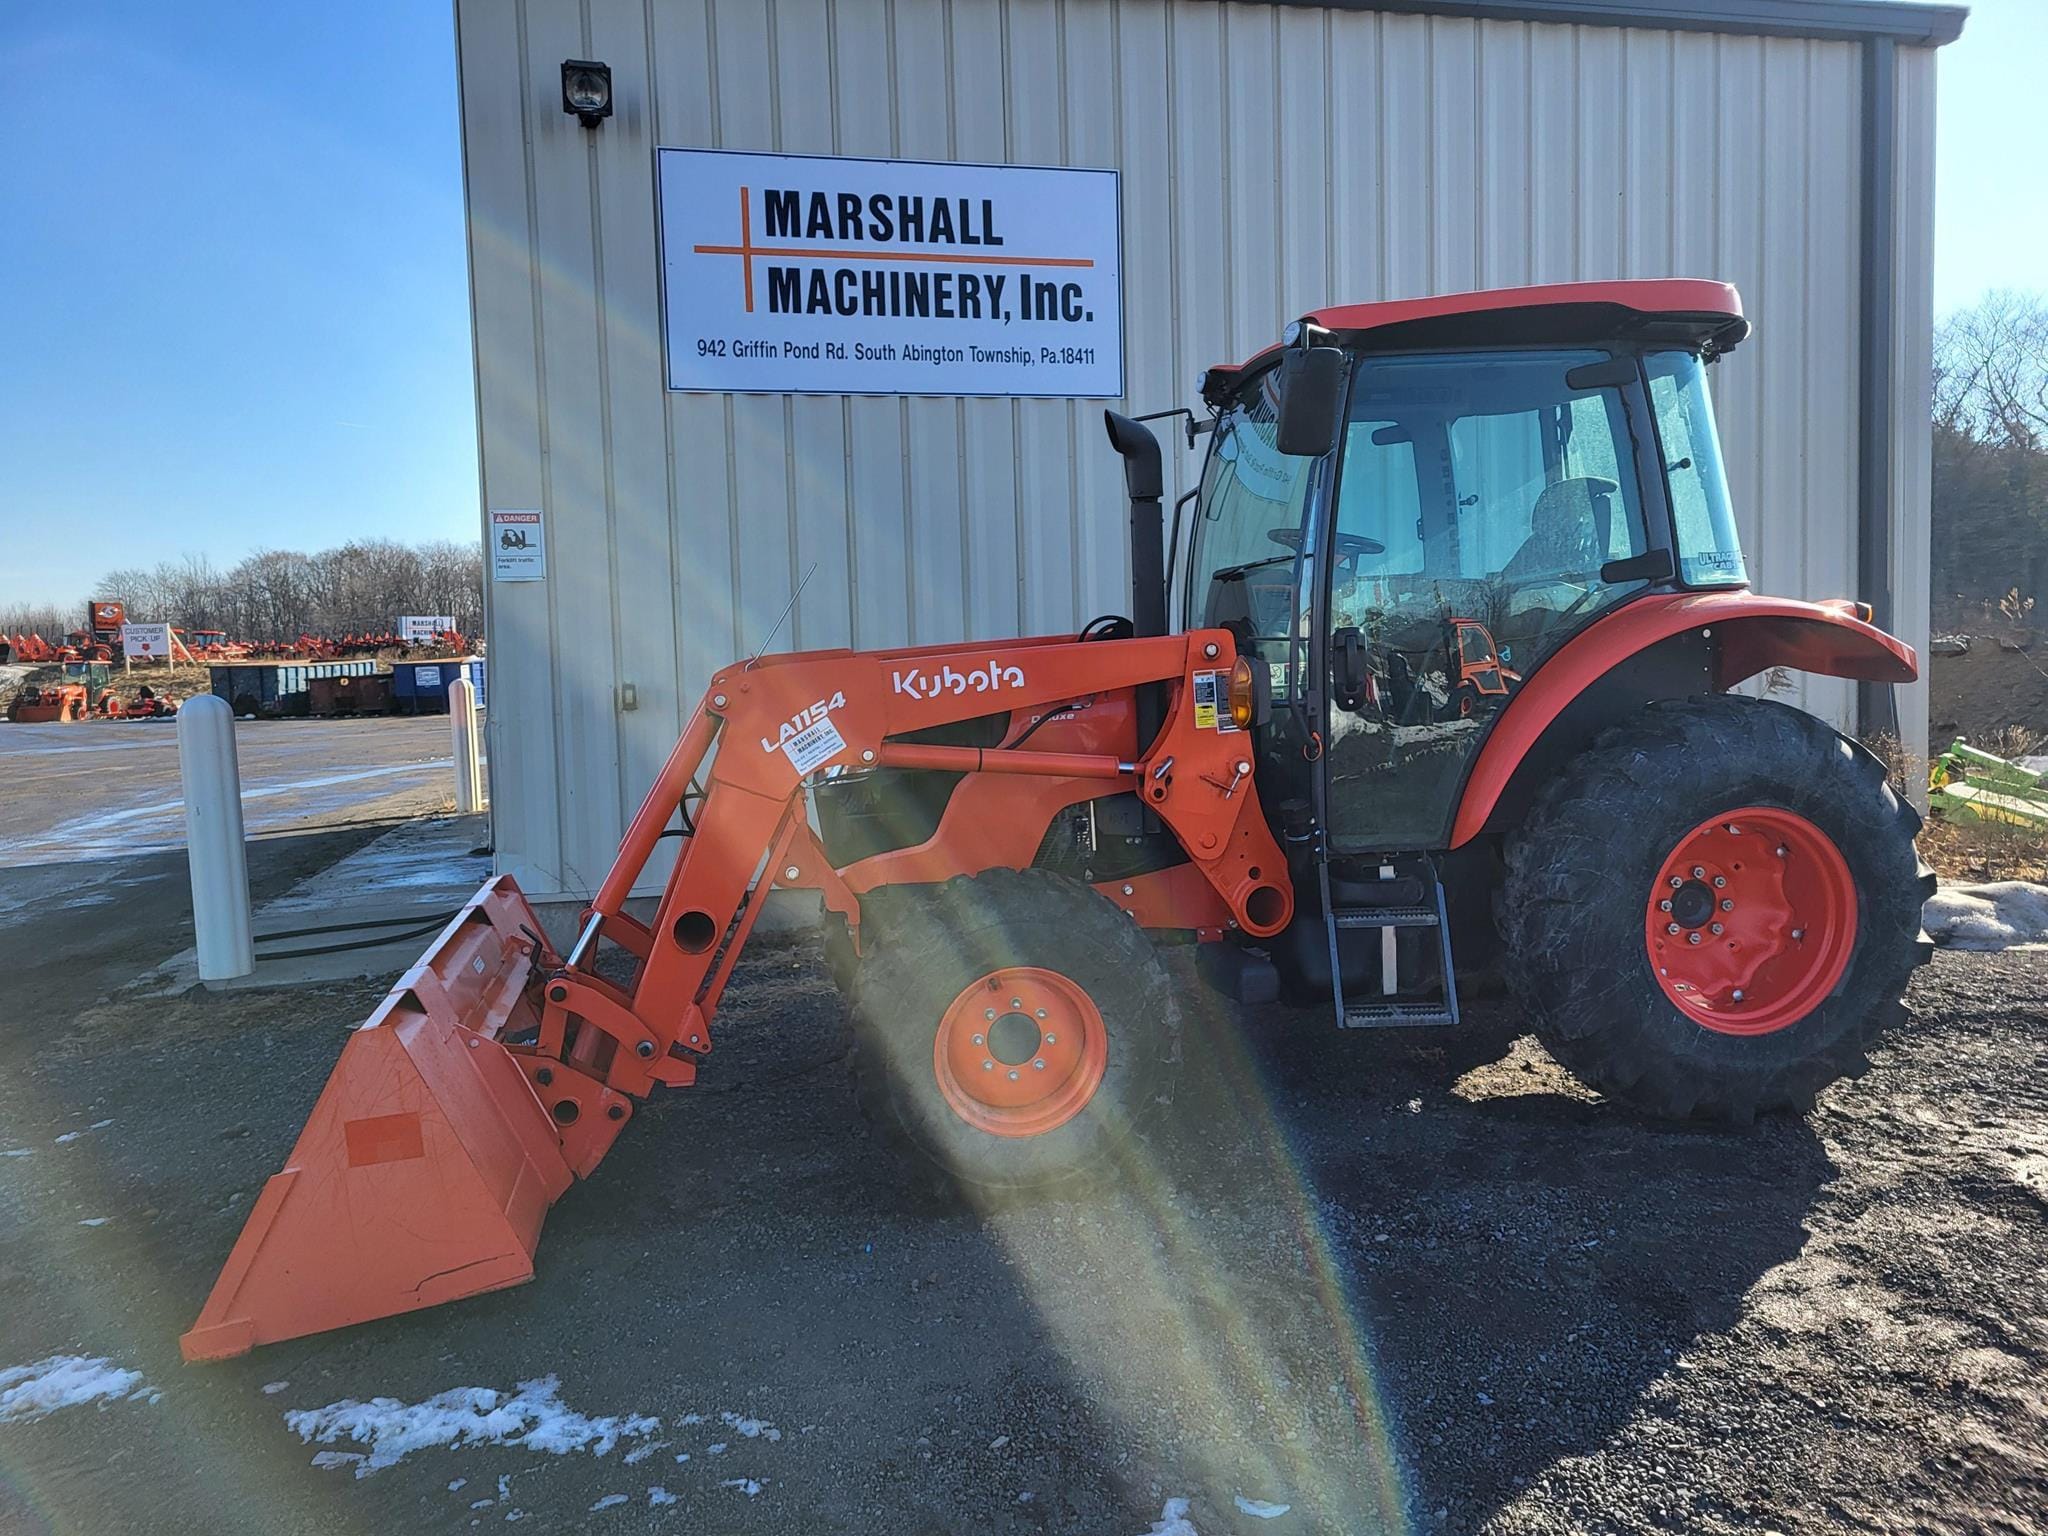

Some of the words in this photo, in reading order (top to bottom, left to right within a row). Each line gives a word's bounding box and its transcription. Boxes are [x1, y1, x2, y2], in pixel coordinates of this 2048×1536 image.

[764, 189, 1004, 246] MARSHALL
[767, 266, 1011, 326] MACHINERY,
[1020, 273, 1094, 322] Inc.
[697, 339, 726, 357] 942
[732, 340, 777, 358] Griffin
[784, 341, 820, 360] Pond
[825, 342, 849, 360] Rd.
[854, 343, 896, 361] South
[902, 344, 964, 365] Abington
[968, 345, 1036, 367] Township,
[1040, 347, 1095, 365] Pa.18411
[504, 514, 537, 522] DANGER
[125, 627, 164, 635] CUSTOMER
[893, 660, 1025, 700] Kubota
[761, 690, 846, 753] LA1154
[1031, 713, 1075, 724] Duxe
